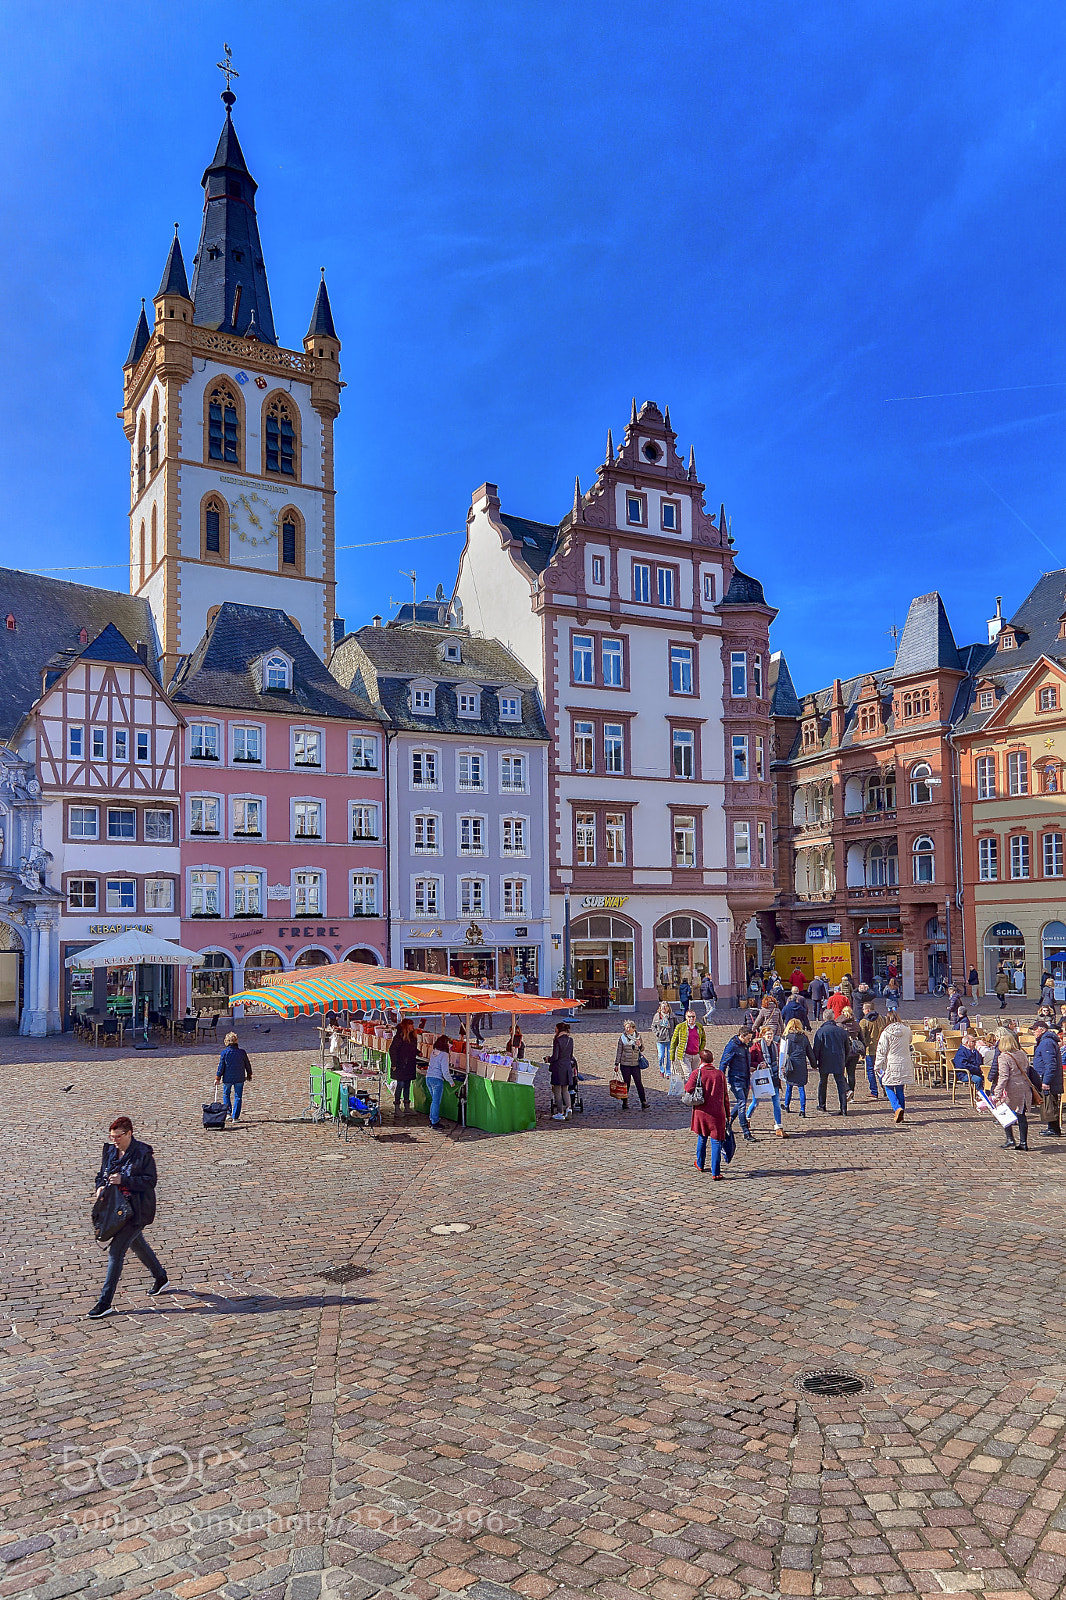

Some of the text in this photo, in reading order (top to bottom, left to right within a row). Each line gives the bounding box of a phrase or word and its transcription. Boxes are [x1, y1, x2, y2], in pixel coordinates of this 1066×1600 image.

[581, 896, 629, 908] SUBWAY
[89, 924, 154, 934] KEBAP HAUS
[408, 926, 437, 938] Lindt
[103, 955, 179, 965] KEBAP HAUS
